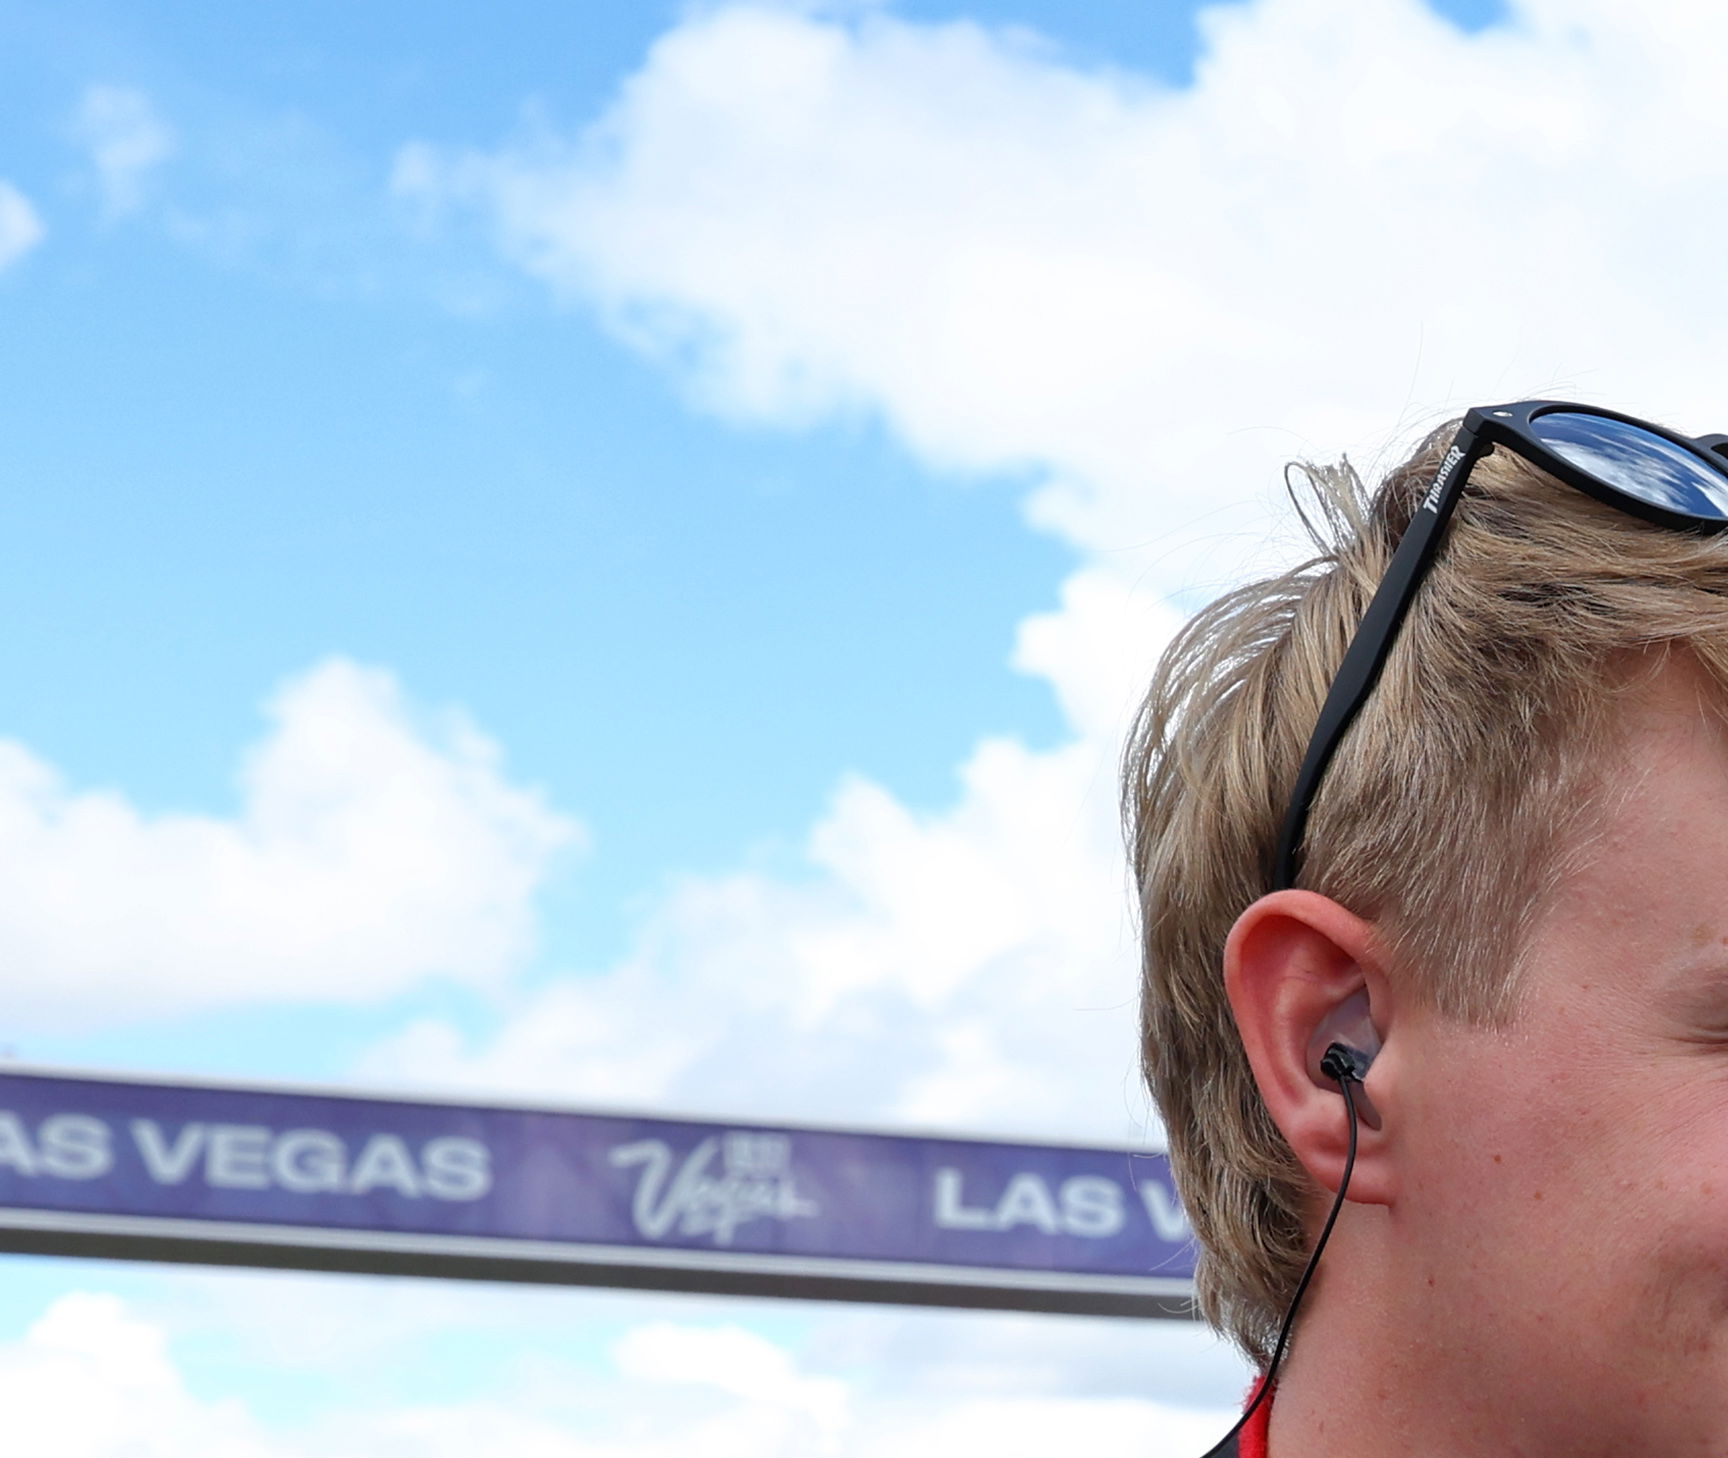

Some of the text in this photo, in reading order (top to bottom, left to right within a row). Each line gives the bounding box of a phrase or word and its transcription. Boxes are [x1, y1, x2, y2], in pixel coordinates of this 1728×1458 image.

[1423, 445, 1466, 514] THRASHER
[130, 1116, 494, 1201] VEGAS
[934, 1168, 1126, 1240] LAS
